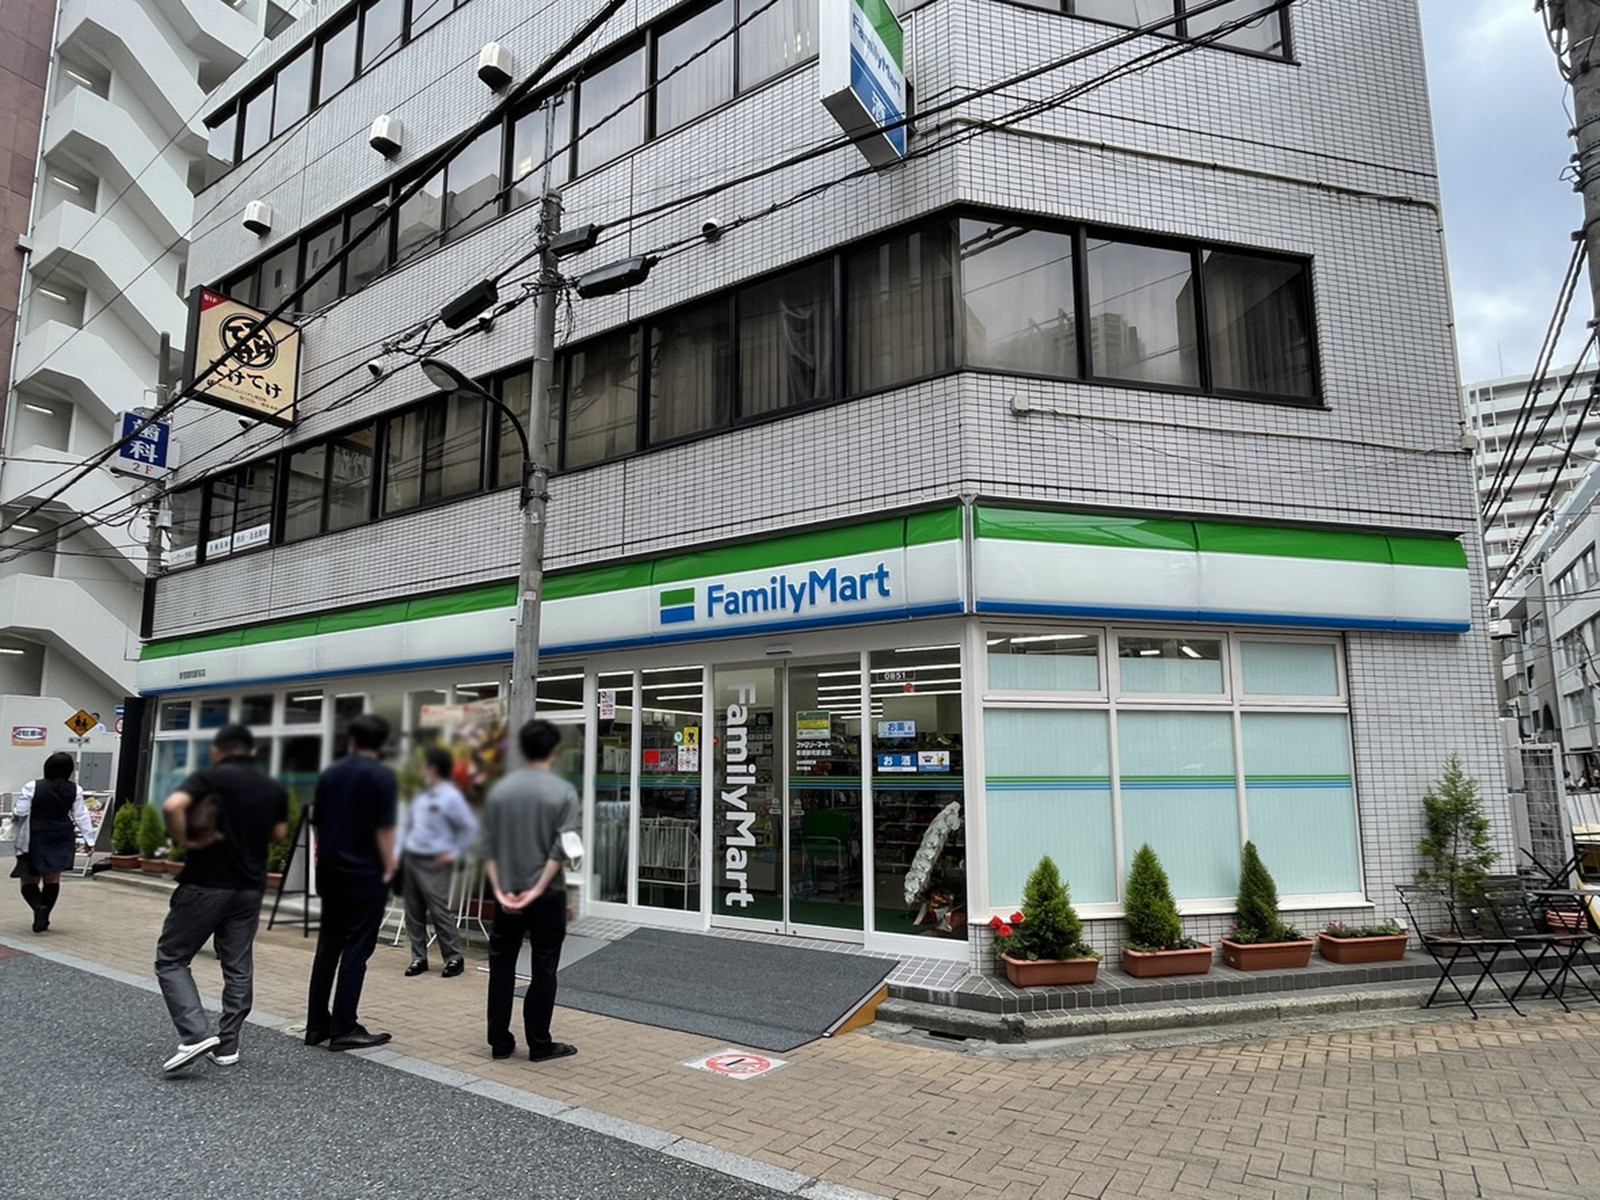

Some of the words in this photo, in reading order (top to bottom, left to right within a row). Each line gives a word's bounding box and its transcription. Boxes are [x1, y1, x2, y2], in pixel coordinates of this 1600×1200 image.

[852, 12, 902, 98] FamilyMart
[129, 418, 161, 463] 歯科
[707, 562, 891, 618] FamilyMart
[884, 672, 906, 680] 0851
[721, 682, 757, 908] FamilyMart
